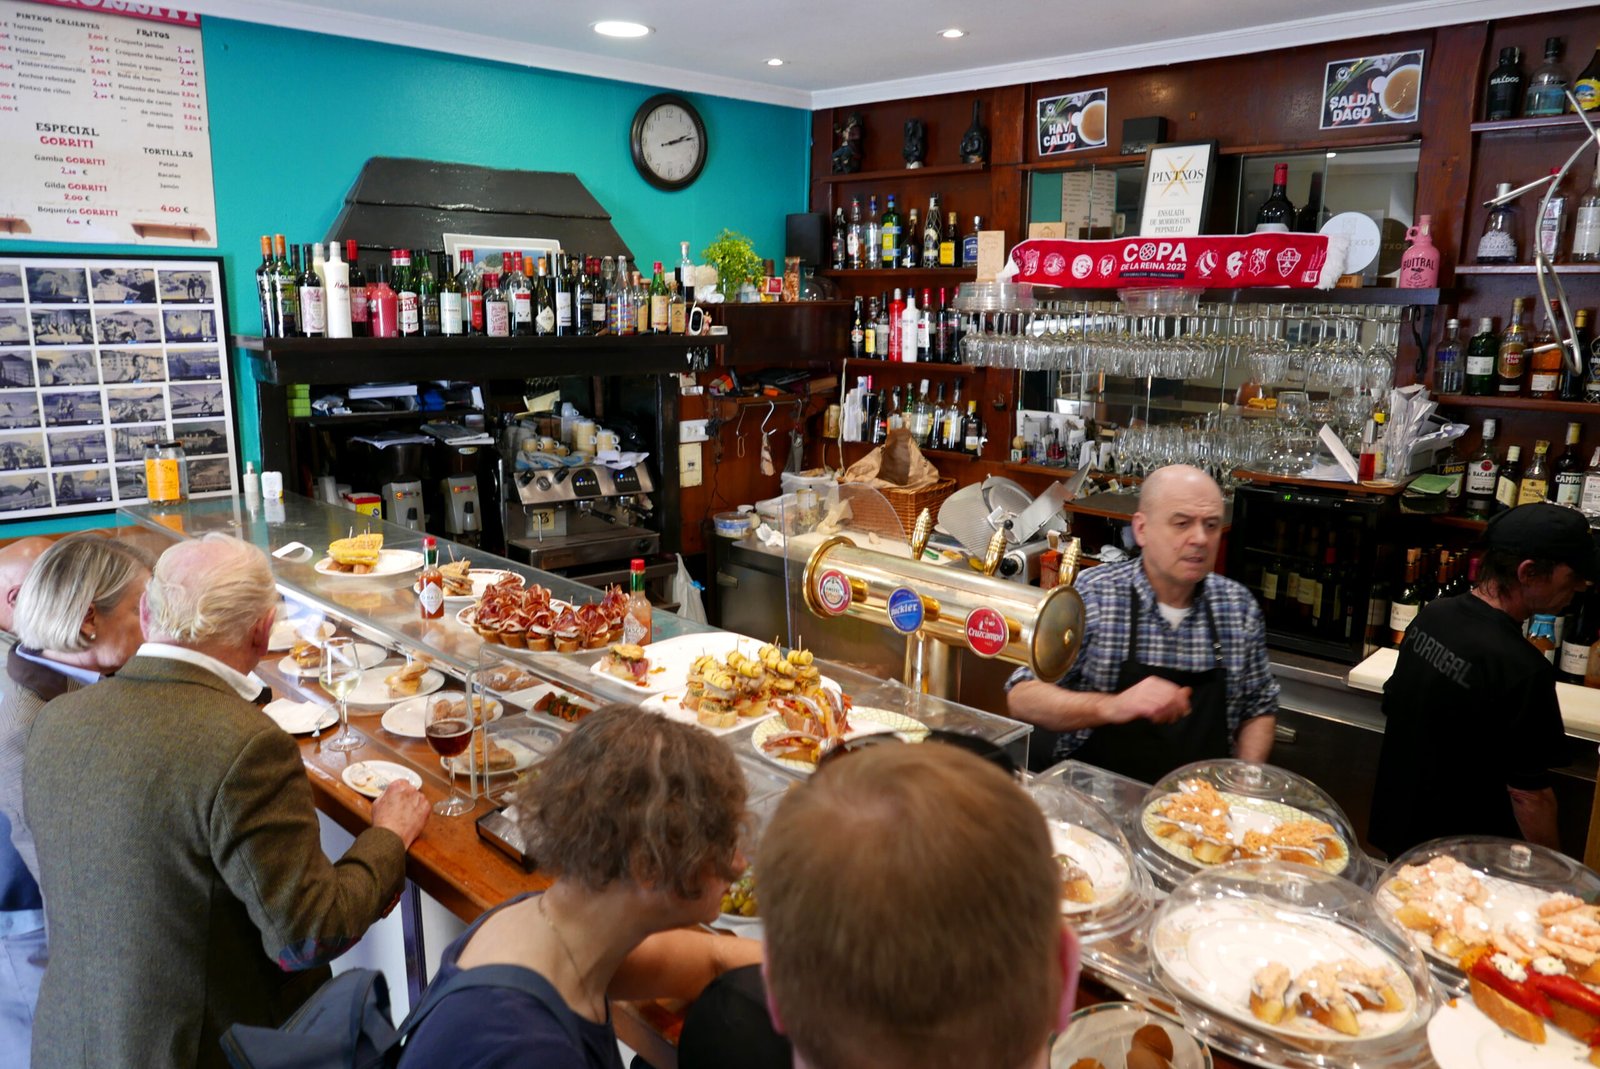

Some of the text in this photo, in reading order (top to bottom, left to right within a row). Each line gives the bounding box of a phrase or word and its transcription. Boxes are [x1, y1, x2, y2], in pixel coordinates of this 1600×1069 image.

[137, 28, 170, 39] FRITOS
[1330, 93, 1377, 109] SALDA
[1332, 107, 1372, 122] DAGO
[35, 122, 100, 136] ESPECIAL
[1049, 121, 1070, 135] HAY
[40, 136, 94, 149] GORRITI
[1043, 132, 1076, 147] CALDO
[143, 147, 194, 159] TORTILLAS
[34, 154, 105, 166] Gamba GORRITI
[158, 161, 179, 169] Patata
[1152, 168, 1205, 183] PINTXOS
[44, 181, 108, 192] Gilda GORRITI
[37, 205, 119, 217] Boquerón GORRITI
[1157, 209, 1185, 217] ENSALADA
[1123, 242, 1188, 263] COPA
[1121, 262, 1187, 271] DE LA REINA 2022
[1403, 257, 1434, 271] BUITRAL
[1555, 475, 1581, 484] CAMPA
[968, 627, 1004, 642] Cruzcampo
[1406, 626, 1471, 689] PORTUGAL
